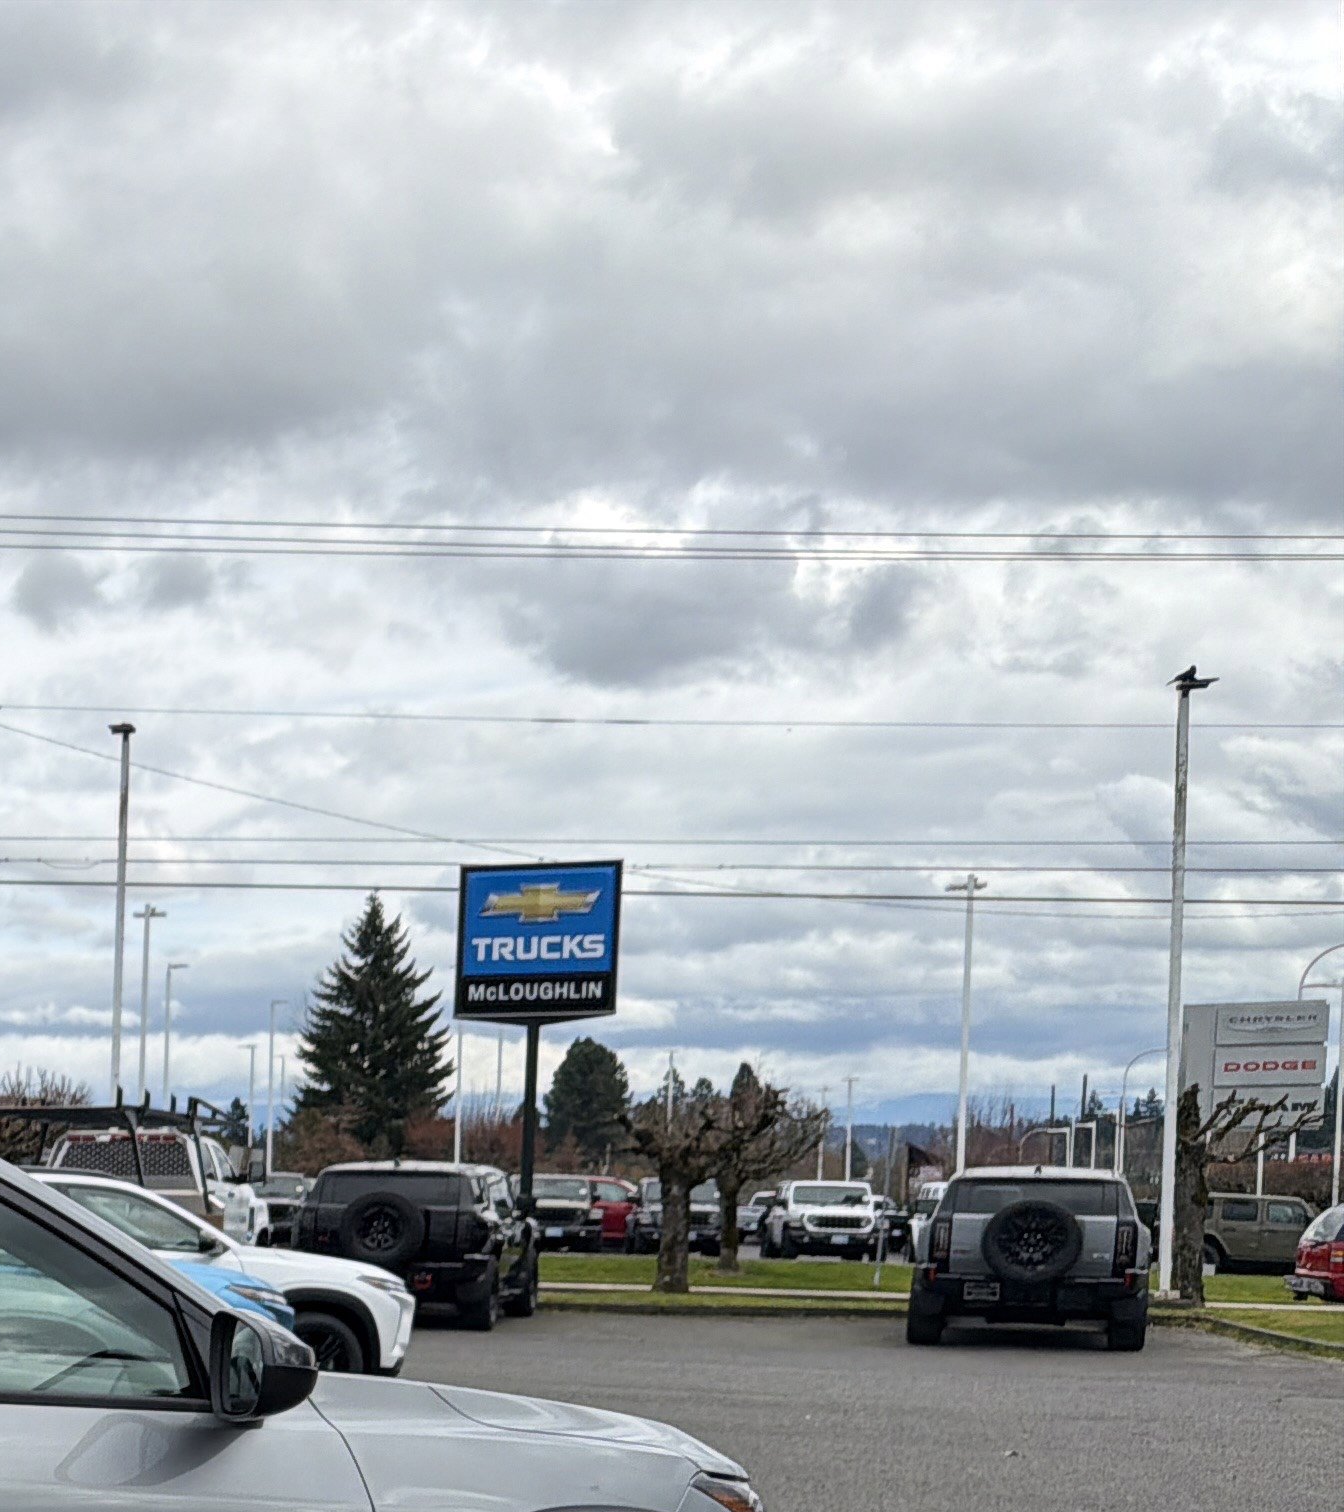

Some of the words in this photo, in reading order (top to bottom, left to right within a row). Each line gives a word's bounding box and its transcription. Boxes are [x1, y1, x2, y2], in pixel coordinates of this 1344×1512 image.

[471, 933, 605, 962] TRUCKS
[467, 980, 603, 1001] McLOUGHLIN
[1223, 1059, 1317, 1073] DODGE
